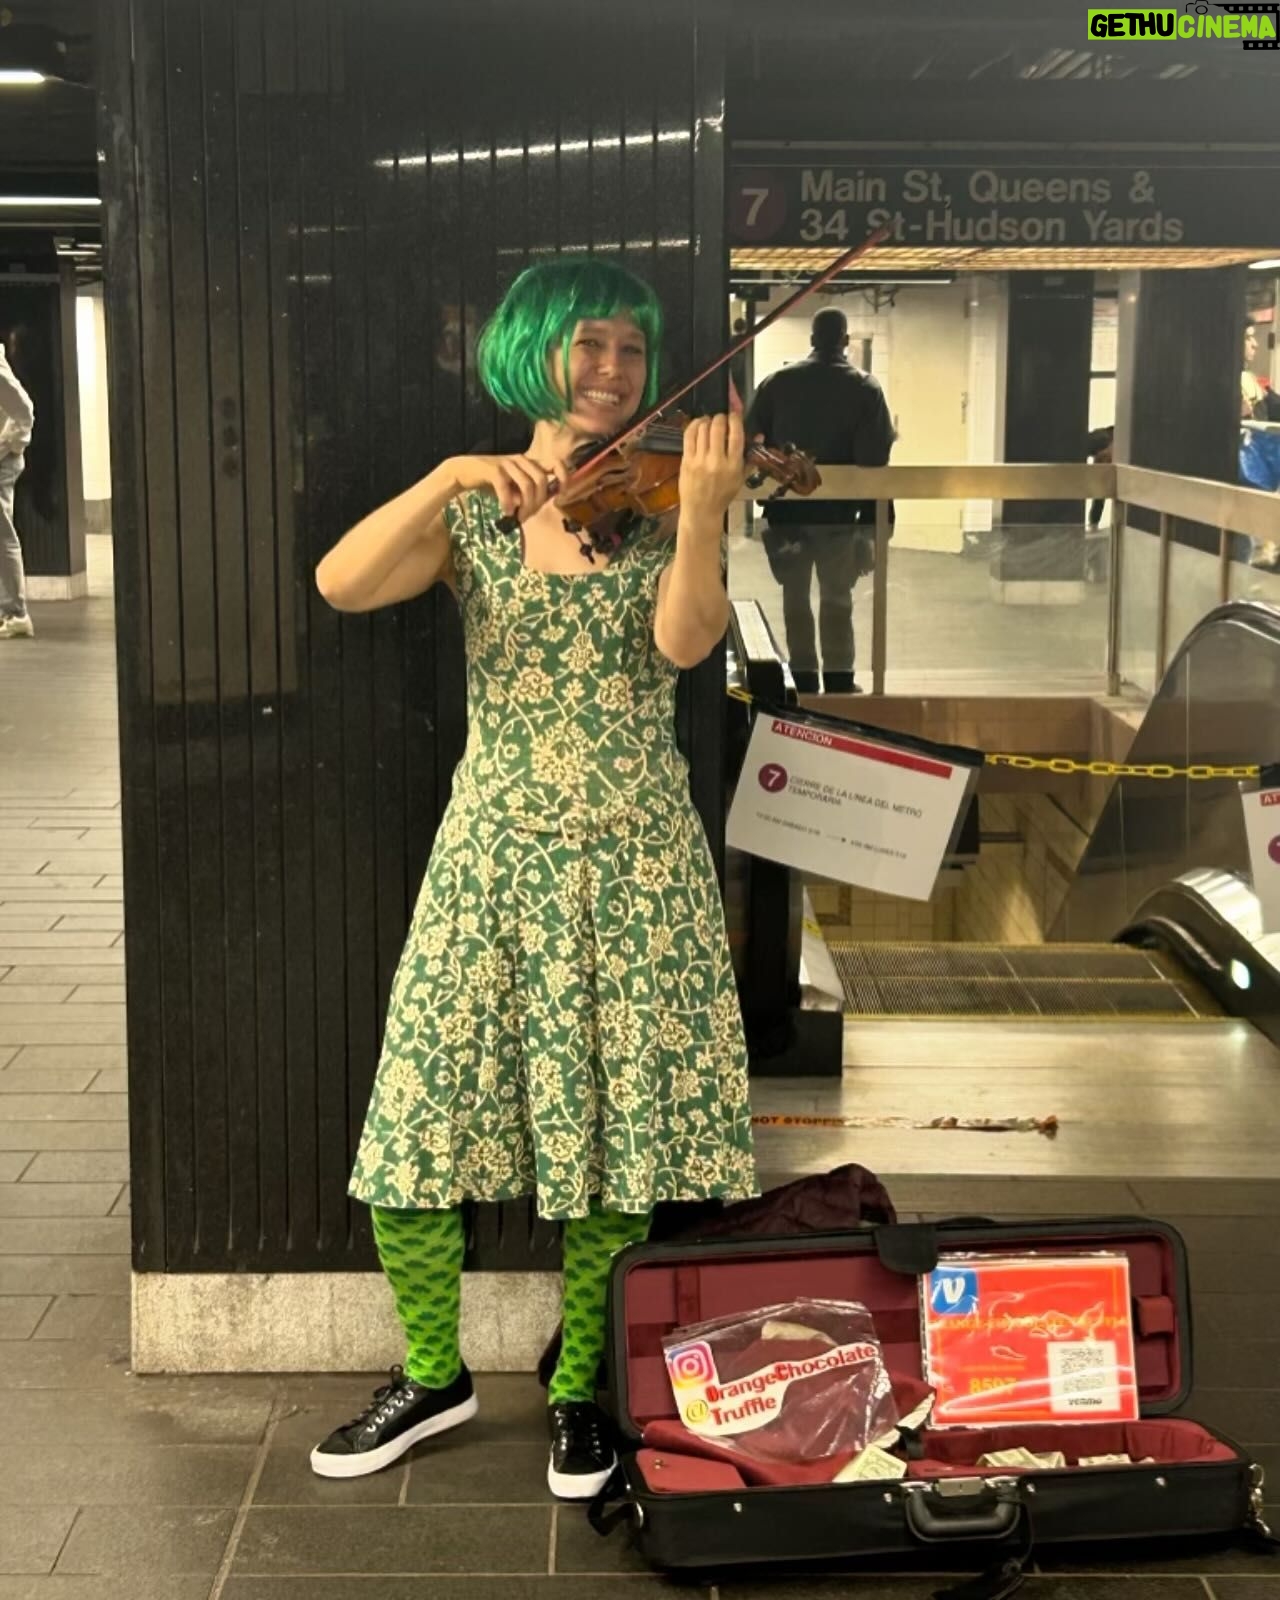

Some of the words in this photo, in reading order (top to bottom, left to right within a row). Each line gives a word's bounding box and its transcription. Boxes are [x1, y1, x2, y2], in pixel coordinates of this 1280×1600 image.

[800, 169, 886, 203] Main
[902, 170, 951, 208] St,
[968, 170, 1111, 204] Queens
[1130, 170, 1155, 203] &
[741, 188, 769, 225] 7
[799, 209, 849, 242] 34
[1083, 209, 1184, 242] Yards
[764, 769, 781, 789] 7
[705, 1344, 876, 1403] OrangeChocolate
[711, 1396, 776, 1426] Truffle
